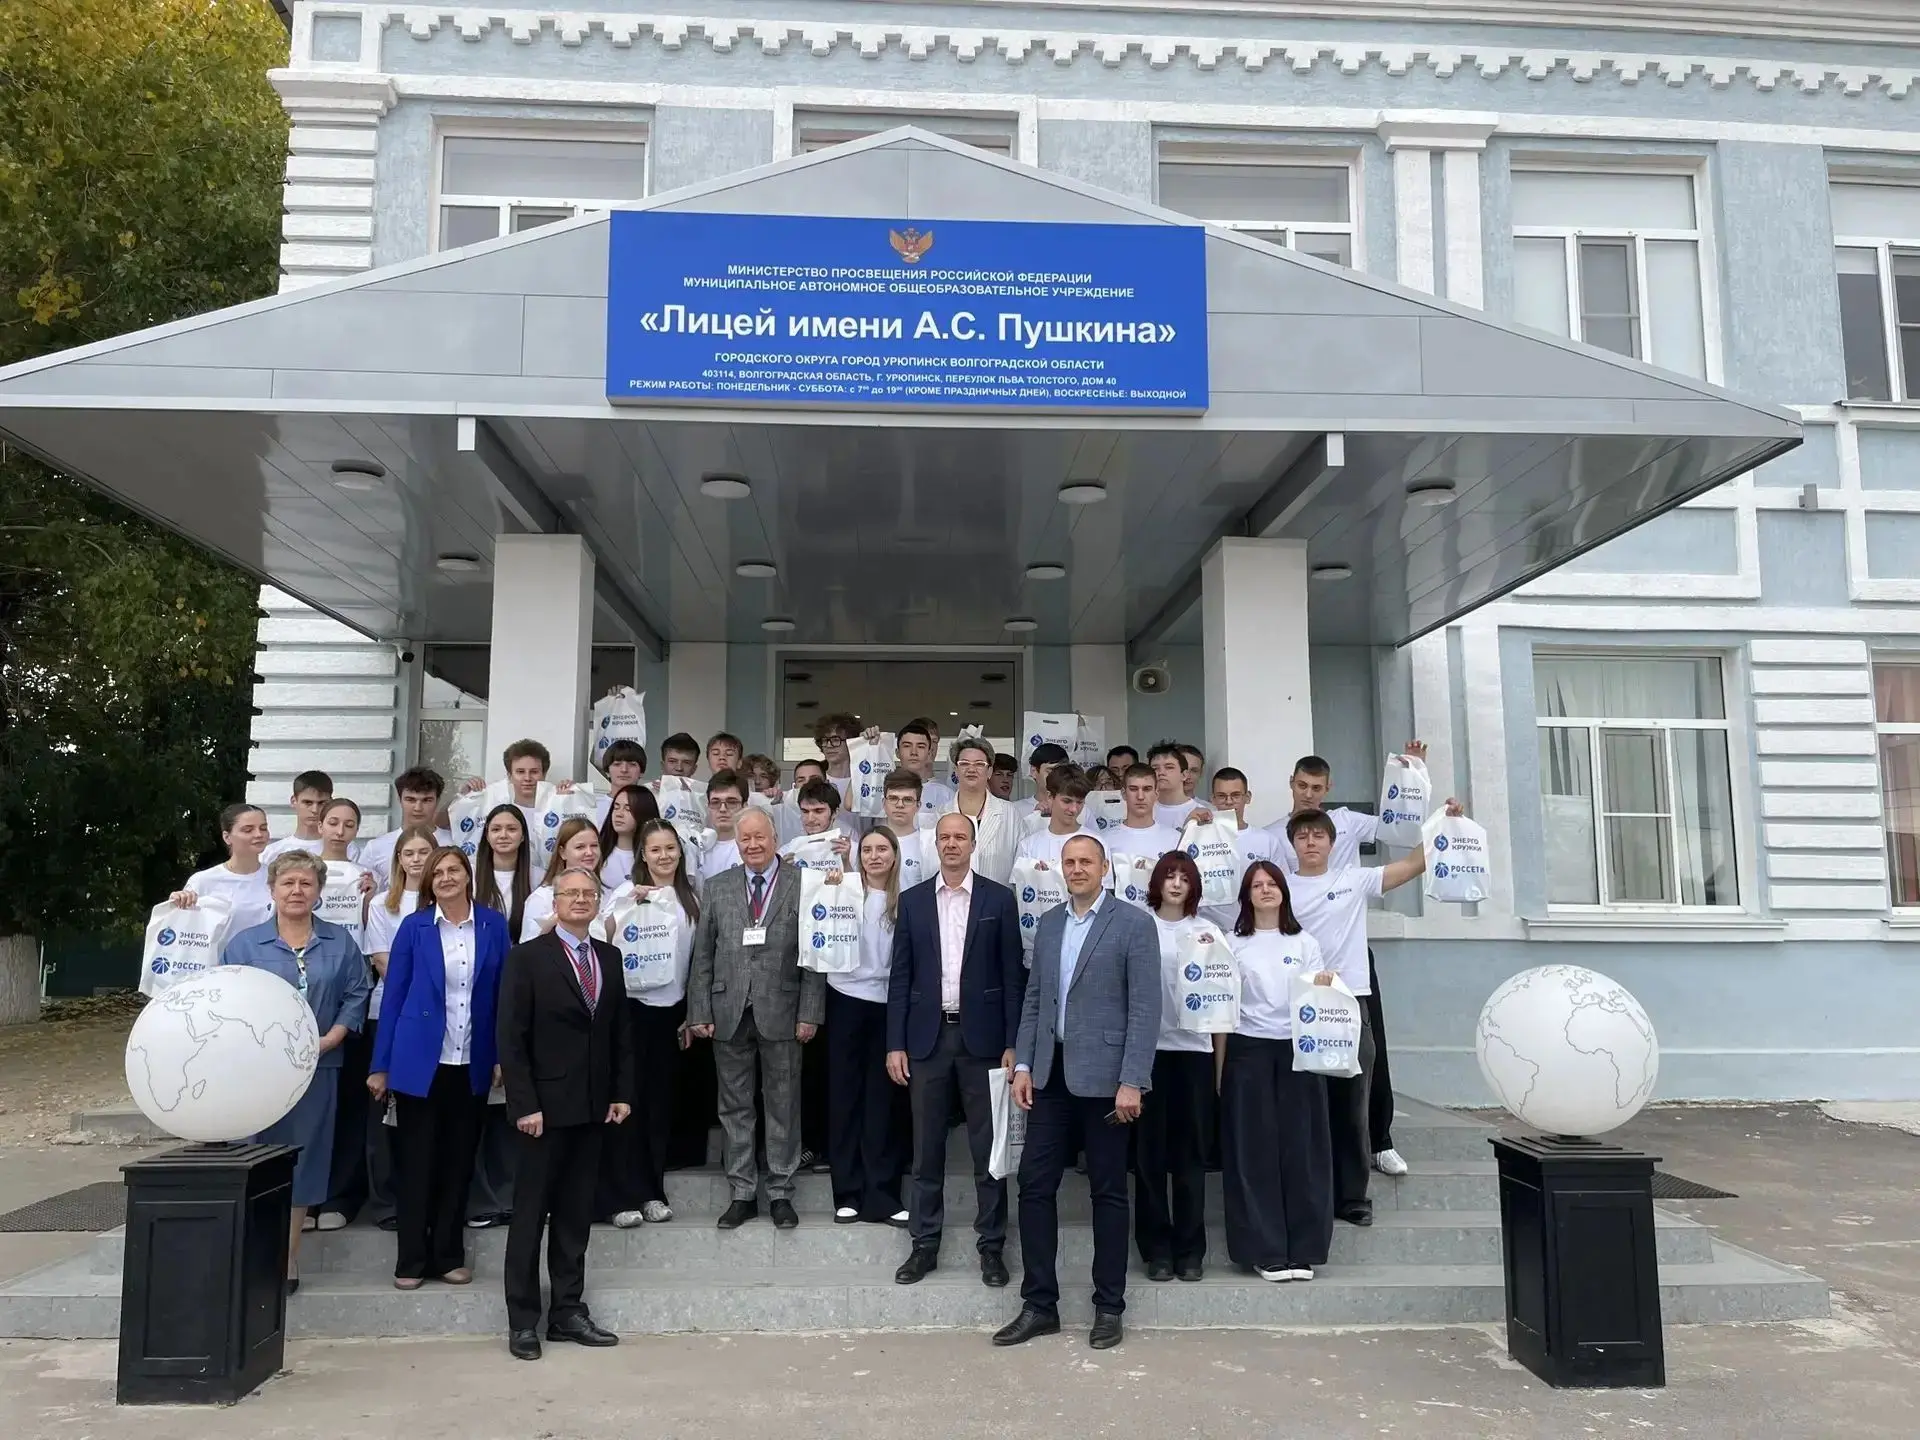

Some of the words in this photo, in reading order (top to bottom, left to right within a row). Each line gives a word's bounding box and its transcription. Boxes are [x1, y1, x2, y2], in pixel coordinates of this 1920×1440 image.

[727, 265, 828, 277] МИНИСТЕРСТВО
[831, 268, 927, 280] ПРОСВЕЩЕНИЯ
[930, 269, 1014, 282] РОССИЙСКОЙ
[1017, 273, 1092, 284] ФЕДЕРАЦИИ
[683, 277, 796, 291] МУНИЦИПАЛЬНОЕ
[799, 281, 886, 293] АВТОНОМНОЕ
[889, 283, 1049, 297] ОБЩЕОБРАЗОВАТЕЛЬНОЕ
[1052, 286, 1134, 298] УЧРЕЖДЕНИЕ
[640, 304, 776, 340] «Лицей
[788, 316, 902, 339] имени
[913, 311, 985, 341] А.С.
[998, 313, 1177, 349] Пушкина»
[715, 352, 792, 364] ГОРОДСКОГО
[795, 355, 839, 365] ОКРУГА
[842, 355, 881, 367] ГОРОД
[883, 356, 948, 367] УРЮПИНСК
[950, 358, 1048, 370] ВОЛГОГРАДСКОЙ
[1050, 360, 1104, 370] ОБЛАСТИ
[702, 369, 737, 379] 403114,
[739, 370, 823, 381] ВОЛГОГРАДСКАЯ
[825, 372, 874, 382] ОБЛАСТЬ,
[876, 373, 883, 381] Г.
[885, 373, 943, 384] УРЮПИНСК,
[945, 375, 996, 384] ПЕРЕУЛОК
[998, 376, 1025, 384] ЛЬВА
[1081, 377, 1104, 386] ДОМ
[1105, 377, 1117, 386] 40
[629, 379, 667, 389] РЕЖИМ
[668, 380, 714, 390] РАБОТЫ:
[716, 382, 791, 392] ПОНЕДЕЛЬНИК
[798, 384, 847, 393] СУББОТА:
[871, 387, 884, 395] до
[905, 386, 941, 397] (КРОМЕ
[943, 387, 1017, 397] ПРАЗДНИЧНЫХ
[1019, 387, 1052, 398] ДНЕЙ),
[1054, 389, 1128, 399] ВОСКРЕСЕНЬЕ:
[1130, 390, 1187, 399] ВЫХОДНОЙ
[1202, 849, 1232, 857] КРУЖКИ
[1203, 869, 1235, 878] РОССЕТИ
[1451, 865, 1485, 873] РОССЕТИ
[639, 924, 667, 933] ЭНЕРГО
[180, 931, 209, 940] ЭНЕРГО
[639, 932, 670, 940] КРУЖКИ
[178, 939, 210, 948] КРУЖКИ
[640, 952, 672, 962] РОССЕТИ
[1202, 994, 1234, 1002] РОССЕТИ
[1319, 1008, 1349, 1016] ЭНЕРГО
[1319, 1015, 1351, 1023] КРУЖКИ
[1318, 1039, 1353, 1048] РОССЕТИ
